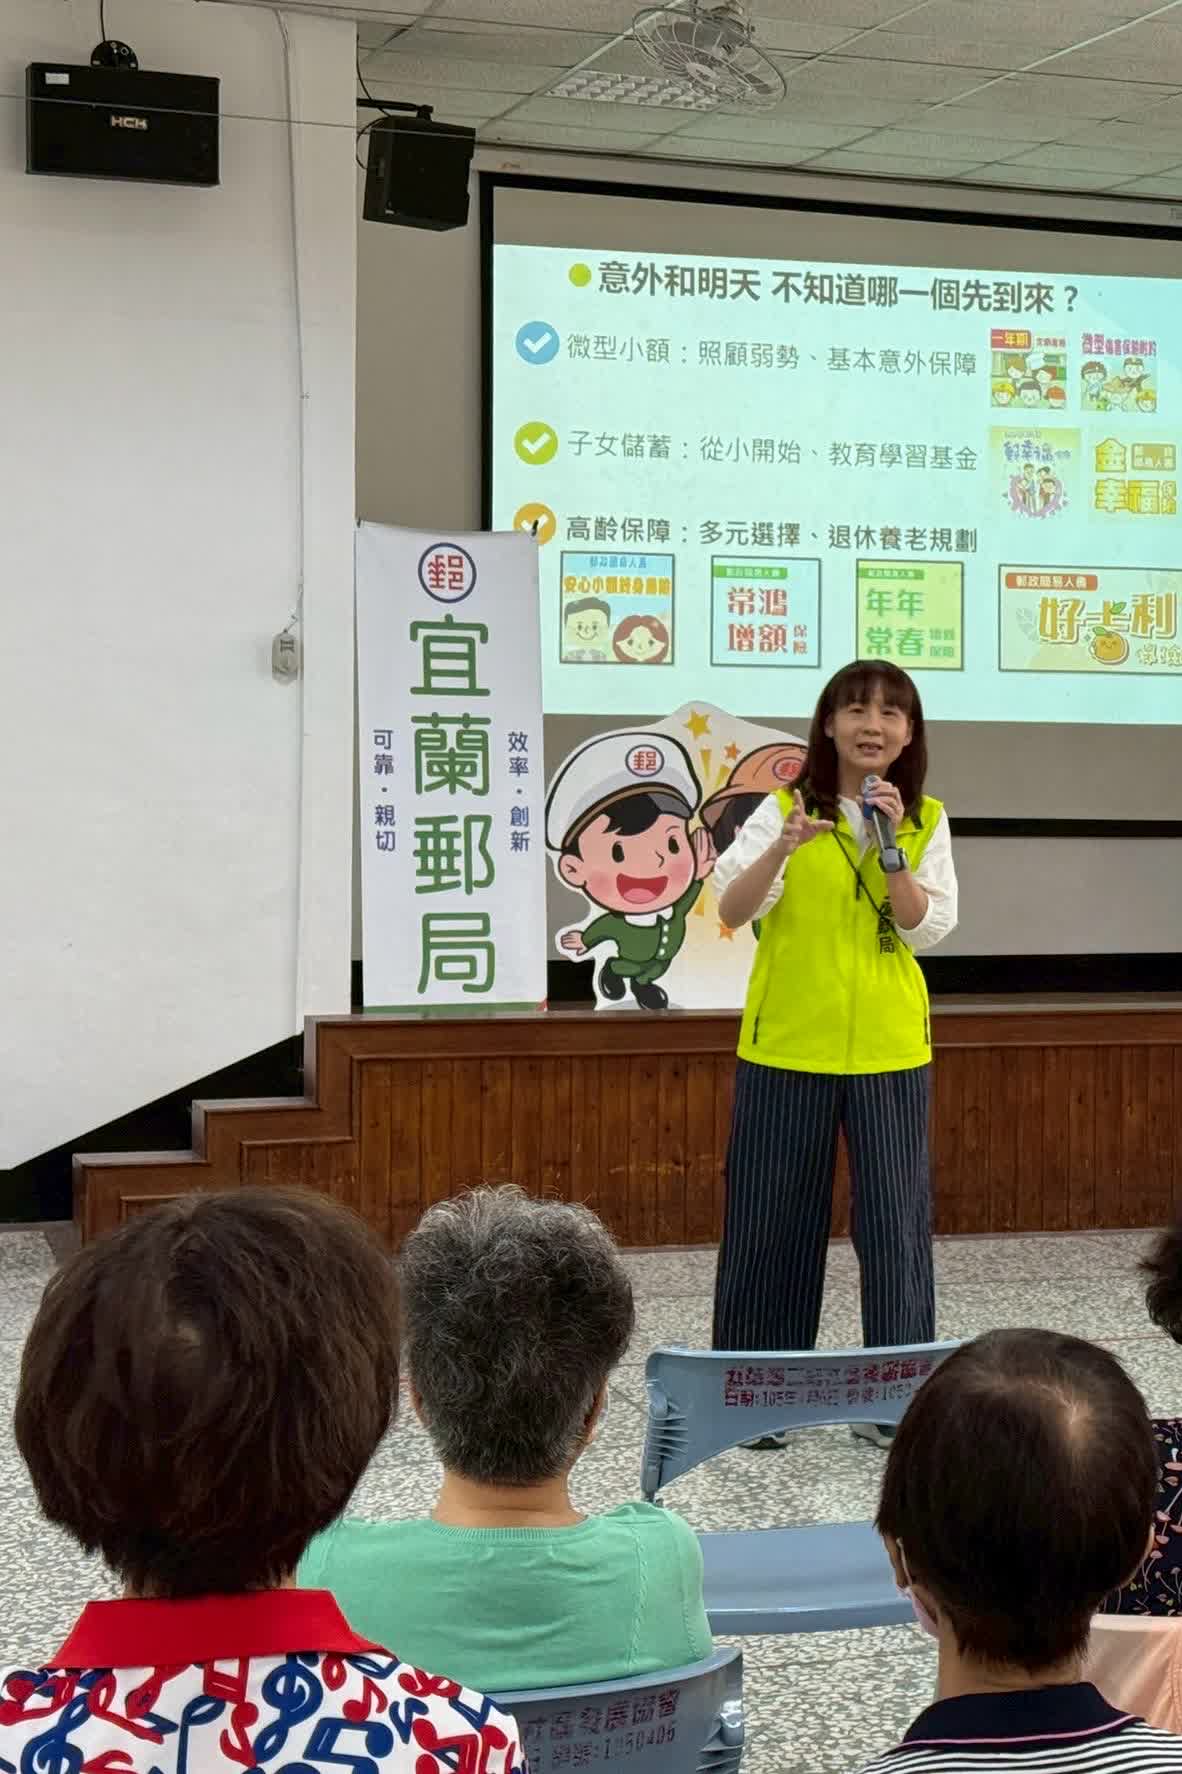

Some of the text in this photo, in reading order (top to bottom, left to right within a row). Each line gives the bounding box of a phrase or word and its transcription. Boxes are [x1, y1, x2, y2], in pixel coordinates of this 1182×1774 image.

[597, 261, 762, 301] 意外和明天
[728, 586, 787, 616] 常鴻
[866, 588, 925, 617] 年年
[728, 623, 788, 653] 增額
[866, 626, 925, 656] 常春
[410, 613, 496, 995] 宜蘭郵局
